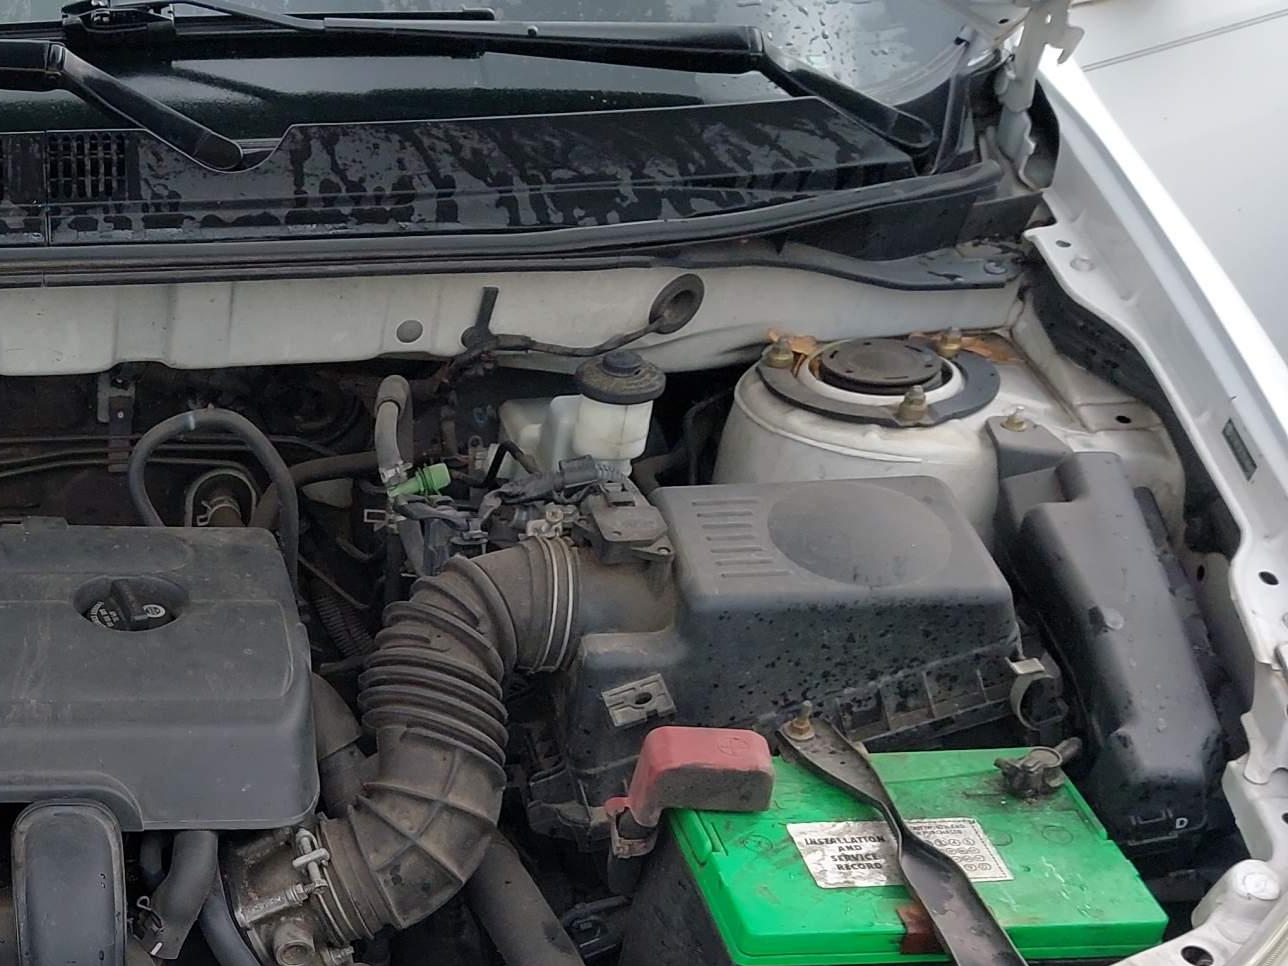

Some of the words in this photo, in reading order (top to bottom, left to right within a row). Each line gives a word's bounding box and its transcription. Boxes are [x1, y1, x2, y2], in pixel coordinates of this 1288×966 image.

[1175, 817, 1188, 829] D
[804, 836, 886, 846] INSTALLATION
[838, 844, 862, 852] AND
[830, 853, 880, 862] SERVICE
[836, 862, 883, 871] RECORD
